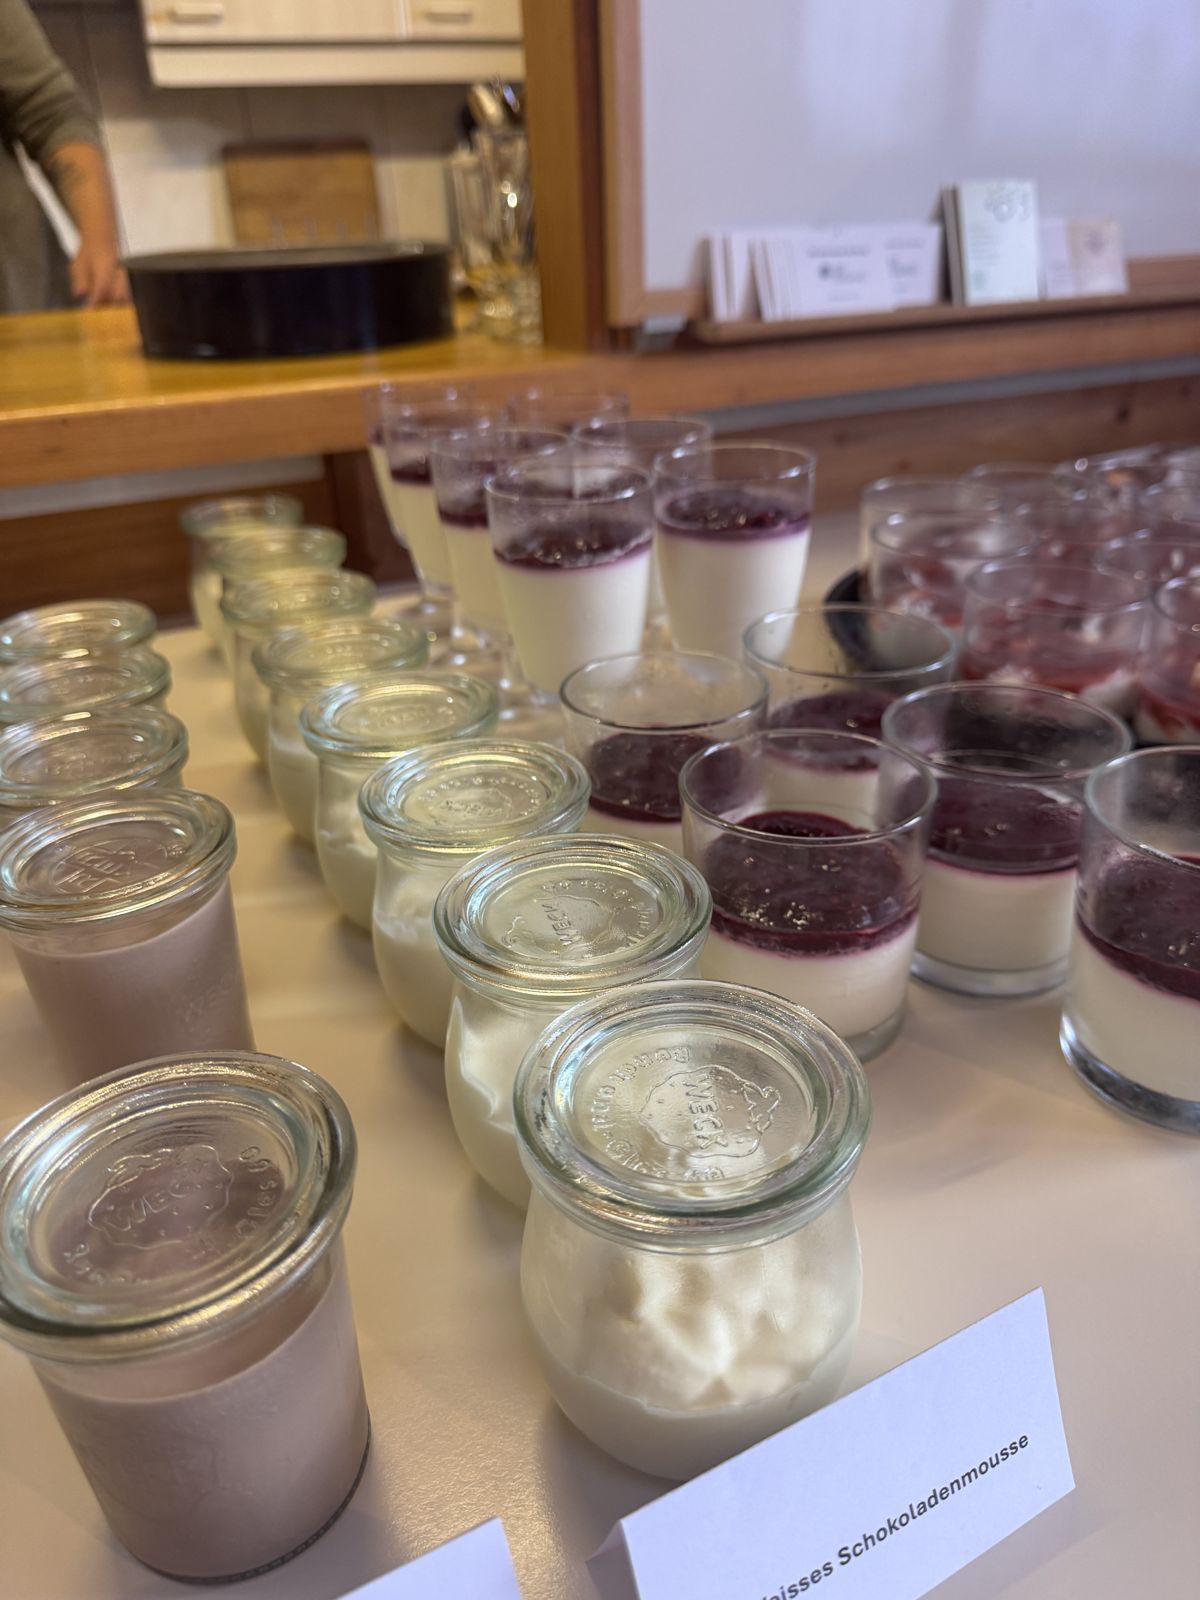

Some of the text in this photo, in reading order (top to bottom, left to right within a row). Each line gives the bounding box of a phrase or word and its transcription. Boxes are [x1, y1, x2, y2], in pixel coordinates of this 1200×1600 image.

[681, 1073, 728, 1150] WECK
[761, 1434, 1030, 1600] isses Schokoladenmousse
